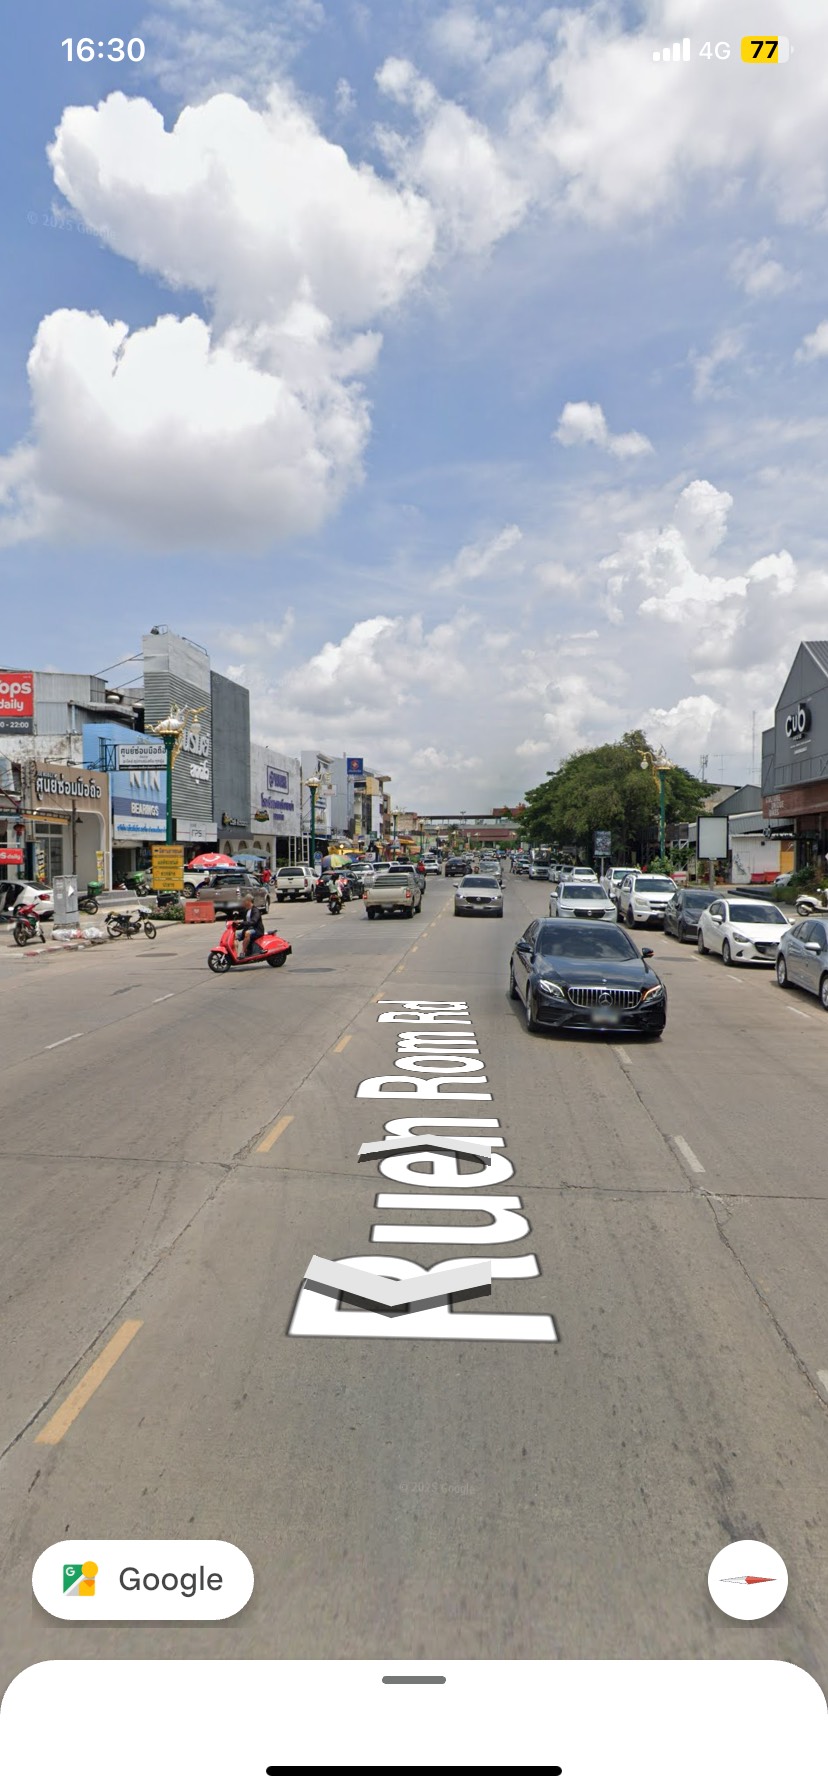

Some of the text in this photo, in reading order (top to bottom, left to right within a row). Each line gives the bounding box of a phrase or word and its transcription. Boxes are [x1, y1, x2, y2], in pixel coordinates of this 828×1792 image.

[0, 698, 24, 712] daily
[120, 746, 167, 757] ศูนย์ซ่อมมือถือ
[36, 773, 103, 801] ศูนย์ซ่อมมือถือ
[131, 802, 160, 816] BEARINGS
